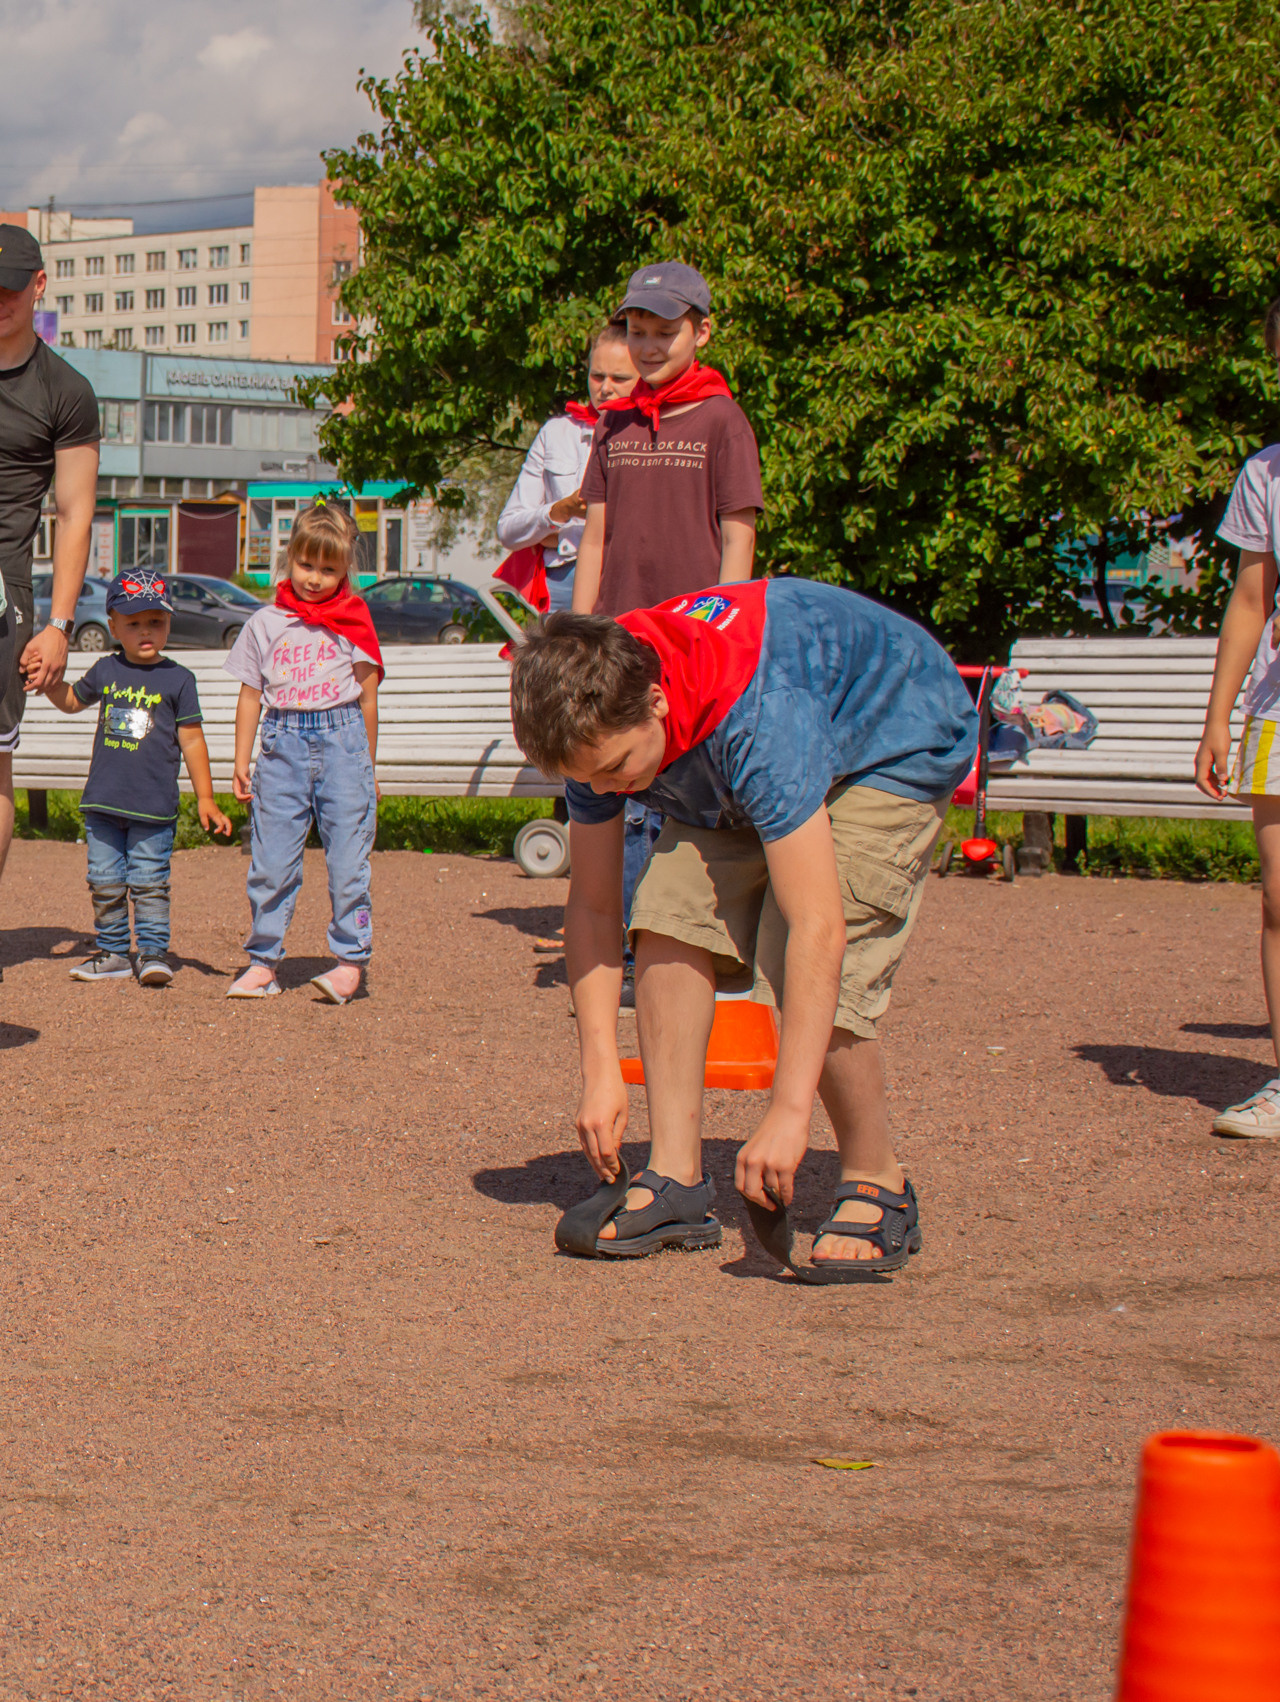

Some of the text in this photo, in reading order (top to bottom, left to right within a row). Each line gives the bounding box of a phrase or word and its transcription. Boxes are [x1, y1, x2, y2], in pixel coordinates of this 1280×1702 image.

[642, 440, 676, 452] LOOK
[676, 440, 708, 453] BACK
[641, 458, 663, 467] JUST
[664, 457, 704, 470] THERE'S
[272, 641, 338, 671] FREE AS
[290, 662, 316, 683] THE
[271, 681, 340, 707] FLOWERS
